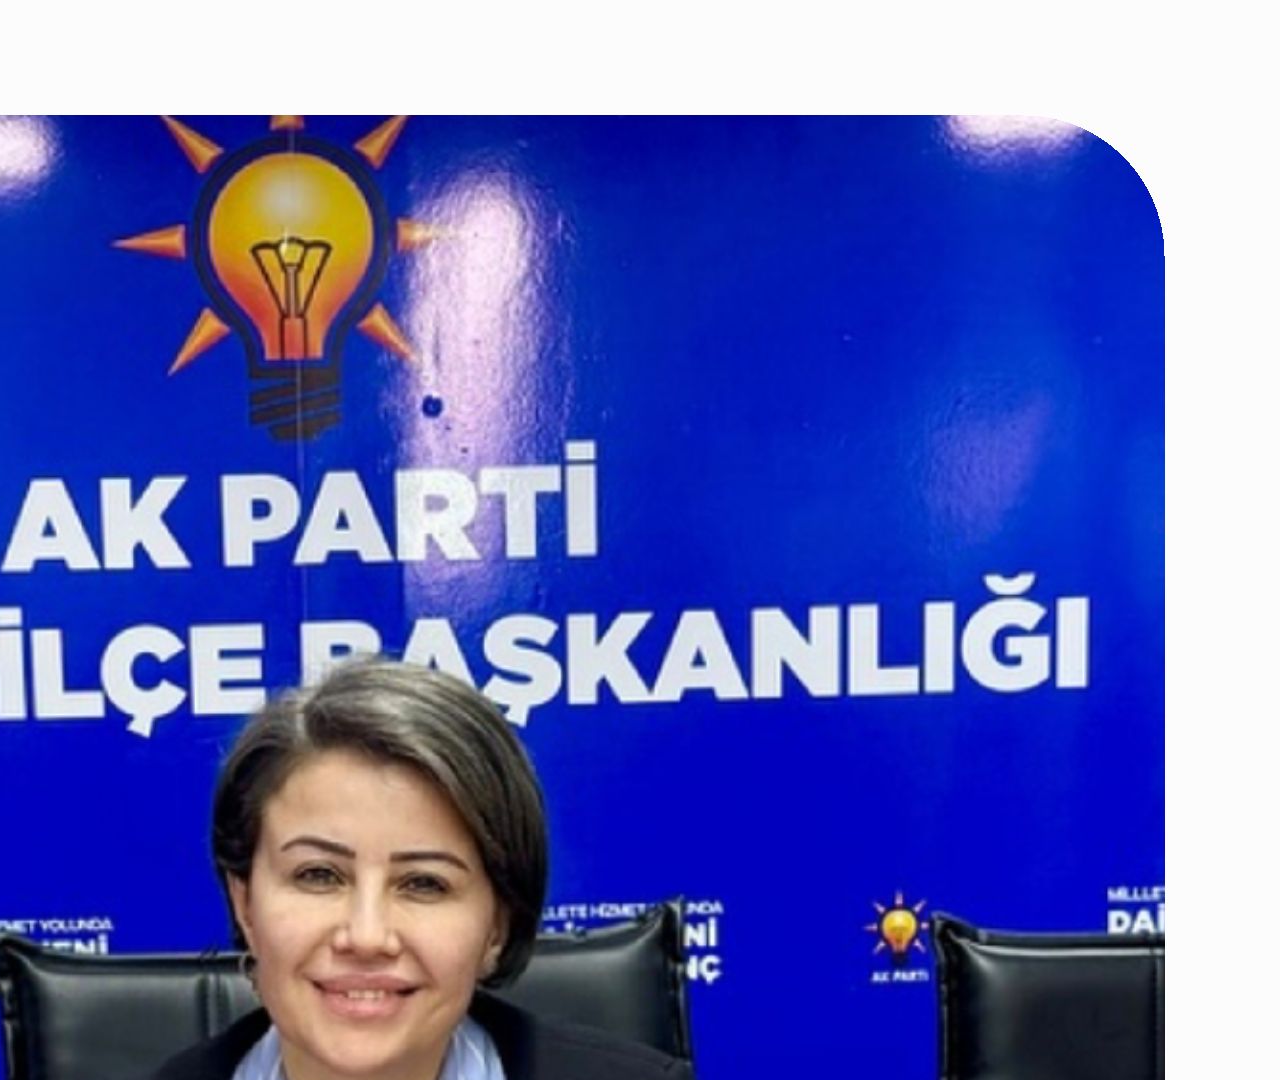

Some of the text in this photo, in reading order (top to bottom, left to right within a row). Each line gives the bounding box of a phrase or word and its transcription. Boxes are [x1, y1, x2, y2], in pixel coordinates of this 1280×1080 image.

[0, 440, 598, 574] AK PARTİ
[299, 572, 1090, 728] BAŞKANLIĞI
[683, 916, 717, 947] Nİ
